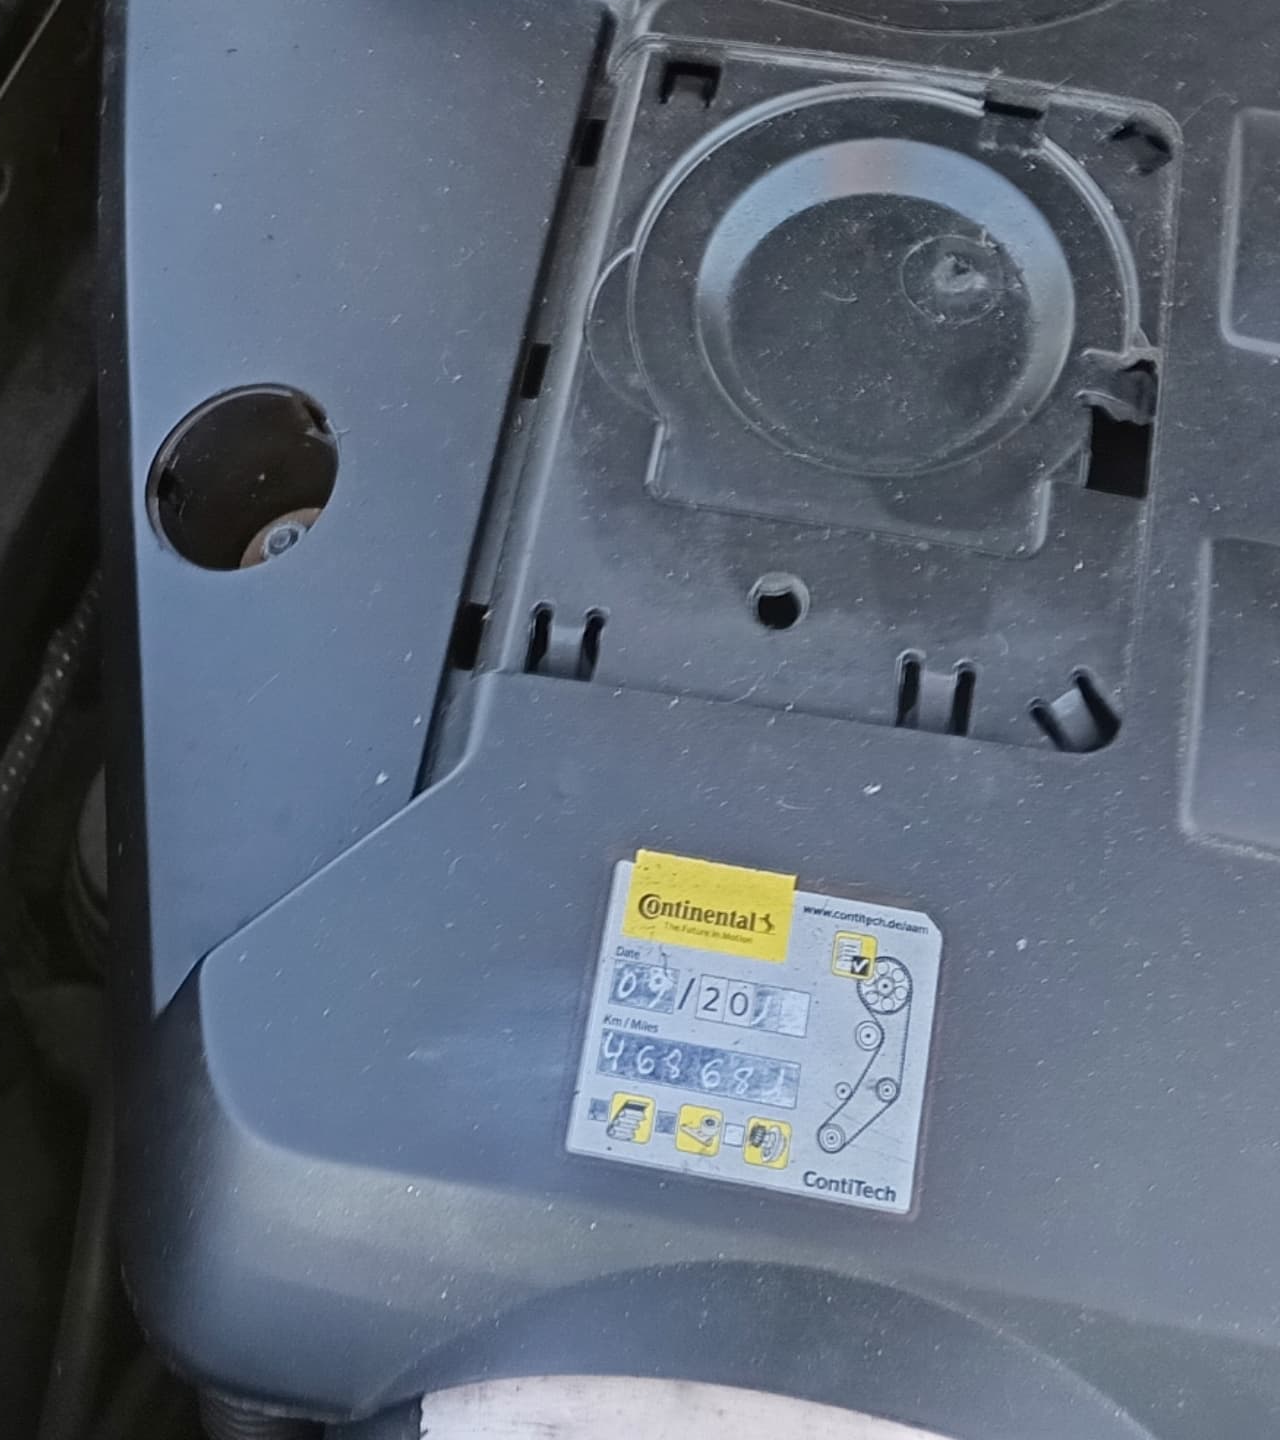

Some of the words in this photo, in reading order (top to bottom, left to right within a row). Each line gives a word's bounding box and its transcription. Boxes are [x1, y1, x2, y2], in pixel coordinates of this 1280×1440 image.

[637, 892, 757, 932] Continental
[615, 945, 640, 960] Date
[631, 1019, 659, 1033] Miles
[802, 1170, 897, 1203] ContiTech
